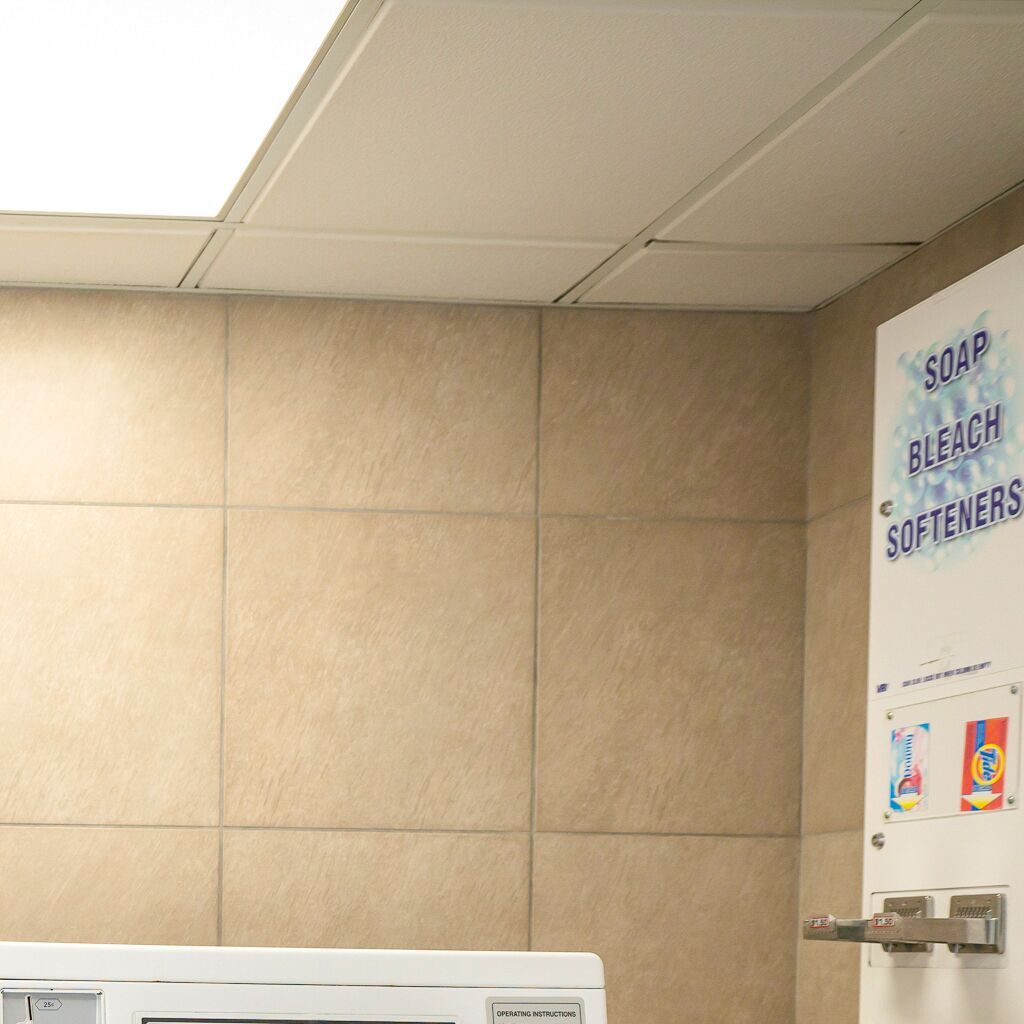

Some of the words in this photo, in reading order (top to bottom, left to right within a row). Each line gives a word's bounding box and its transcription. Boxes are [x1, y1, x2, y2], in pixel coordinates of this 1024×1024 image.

[924, 327, 990, 392] SOAP
[908, 401, 1003, 477] BLEACH
[886, 477, 1024, 561] SOFTENERS
[980, 748, 998, 781] Tide
